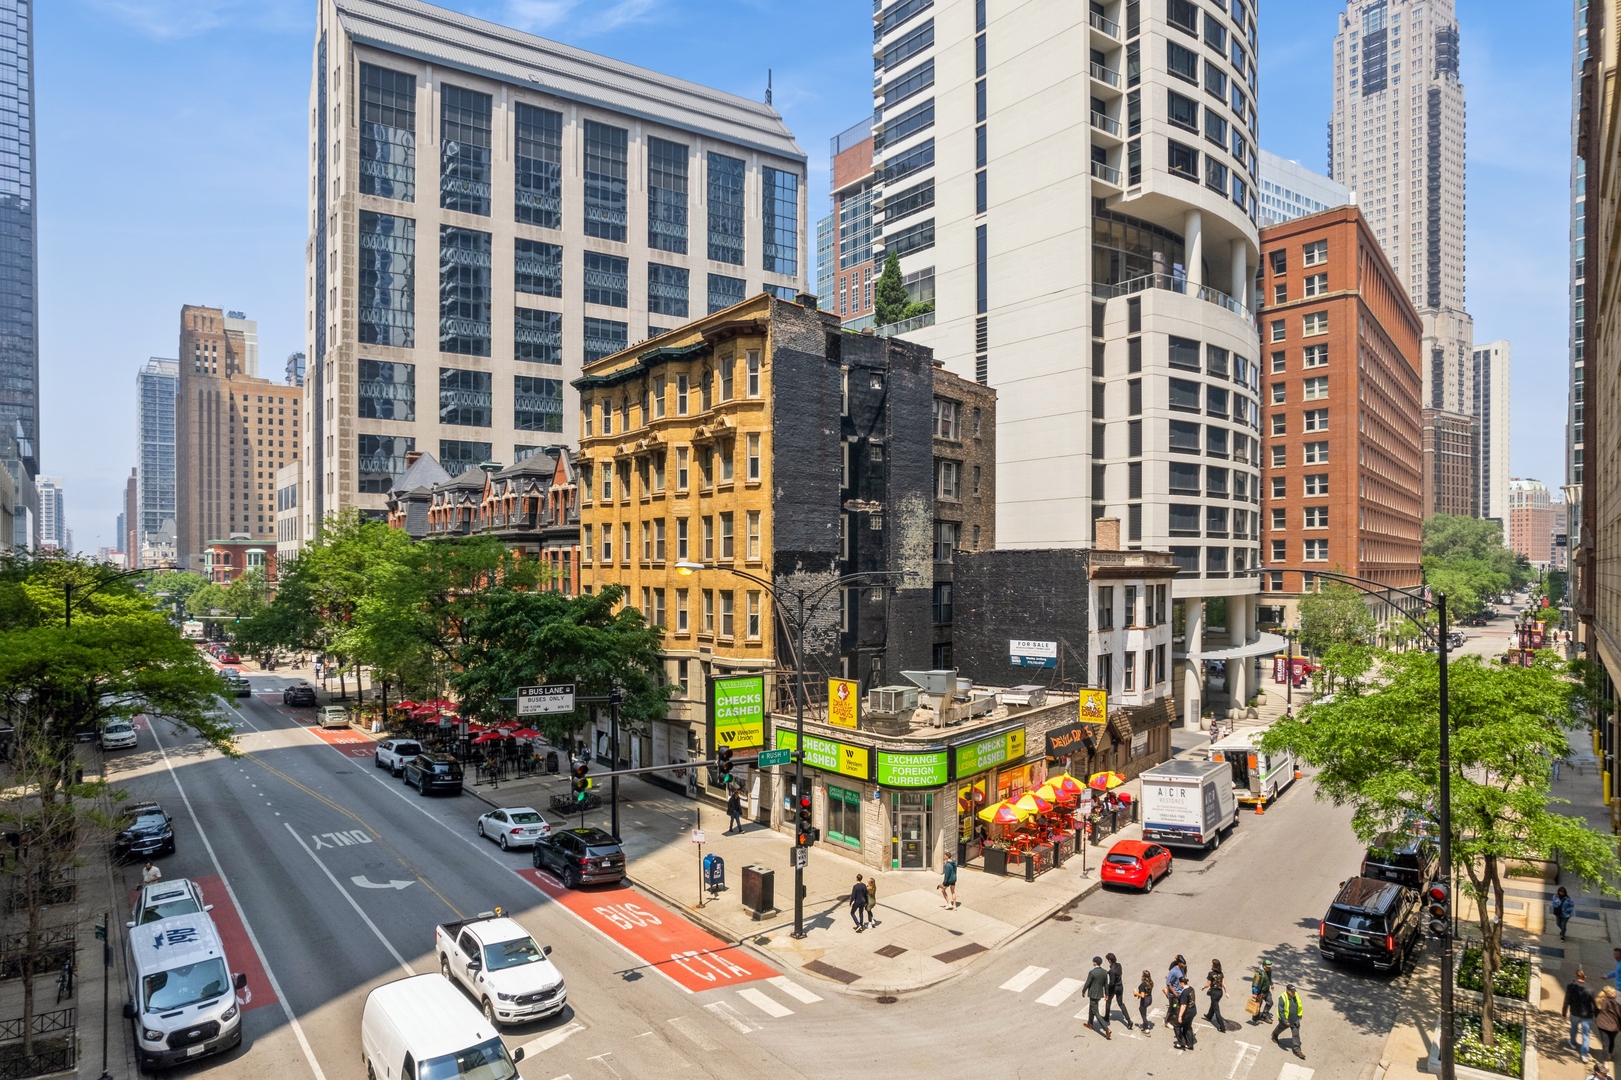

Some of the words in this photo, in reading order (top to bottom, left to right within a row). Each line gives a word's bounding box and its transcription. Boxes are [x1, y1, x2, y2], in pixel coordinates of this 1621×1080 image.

[717, 694, 761, 706] CHECKS
[717, 705, 761, 718] CASHED
[977, 738, 1005, 755] CHECKS
[1050, 733, 1073, 749] DEVIL
[887, 755, 938, 765] EXCHANGE
[962, 750, 975, 760] AUTO
[977, 750, 1006, 768] CASHED
[892, 767, 934, 775] FOREIGN
[958, 759, 977, 772] LICENSE
[887, 775, 938, 784] CURRENCY
[312, 829, 374, 851] ONLY
[593, 902, 662, 930] BUS
[670, 948, 752, 982] CTA
